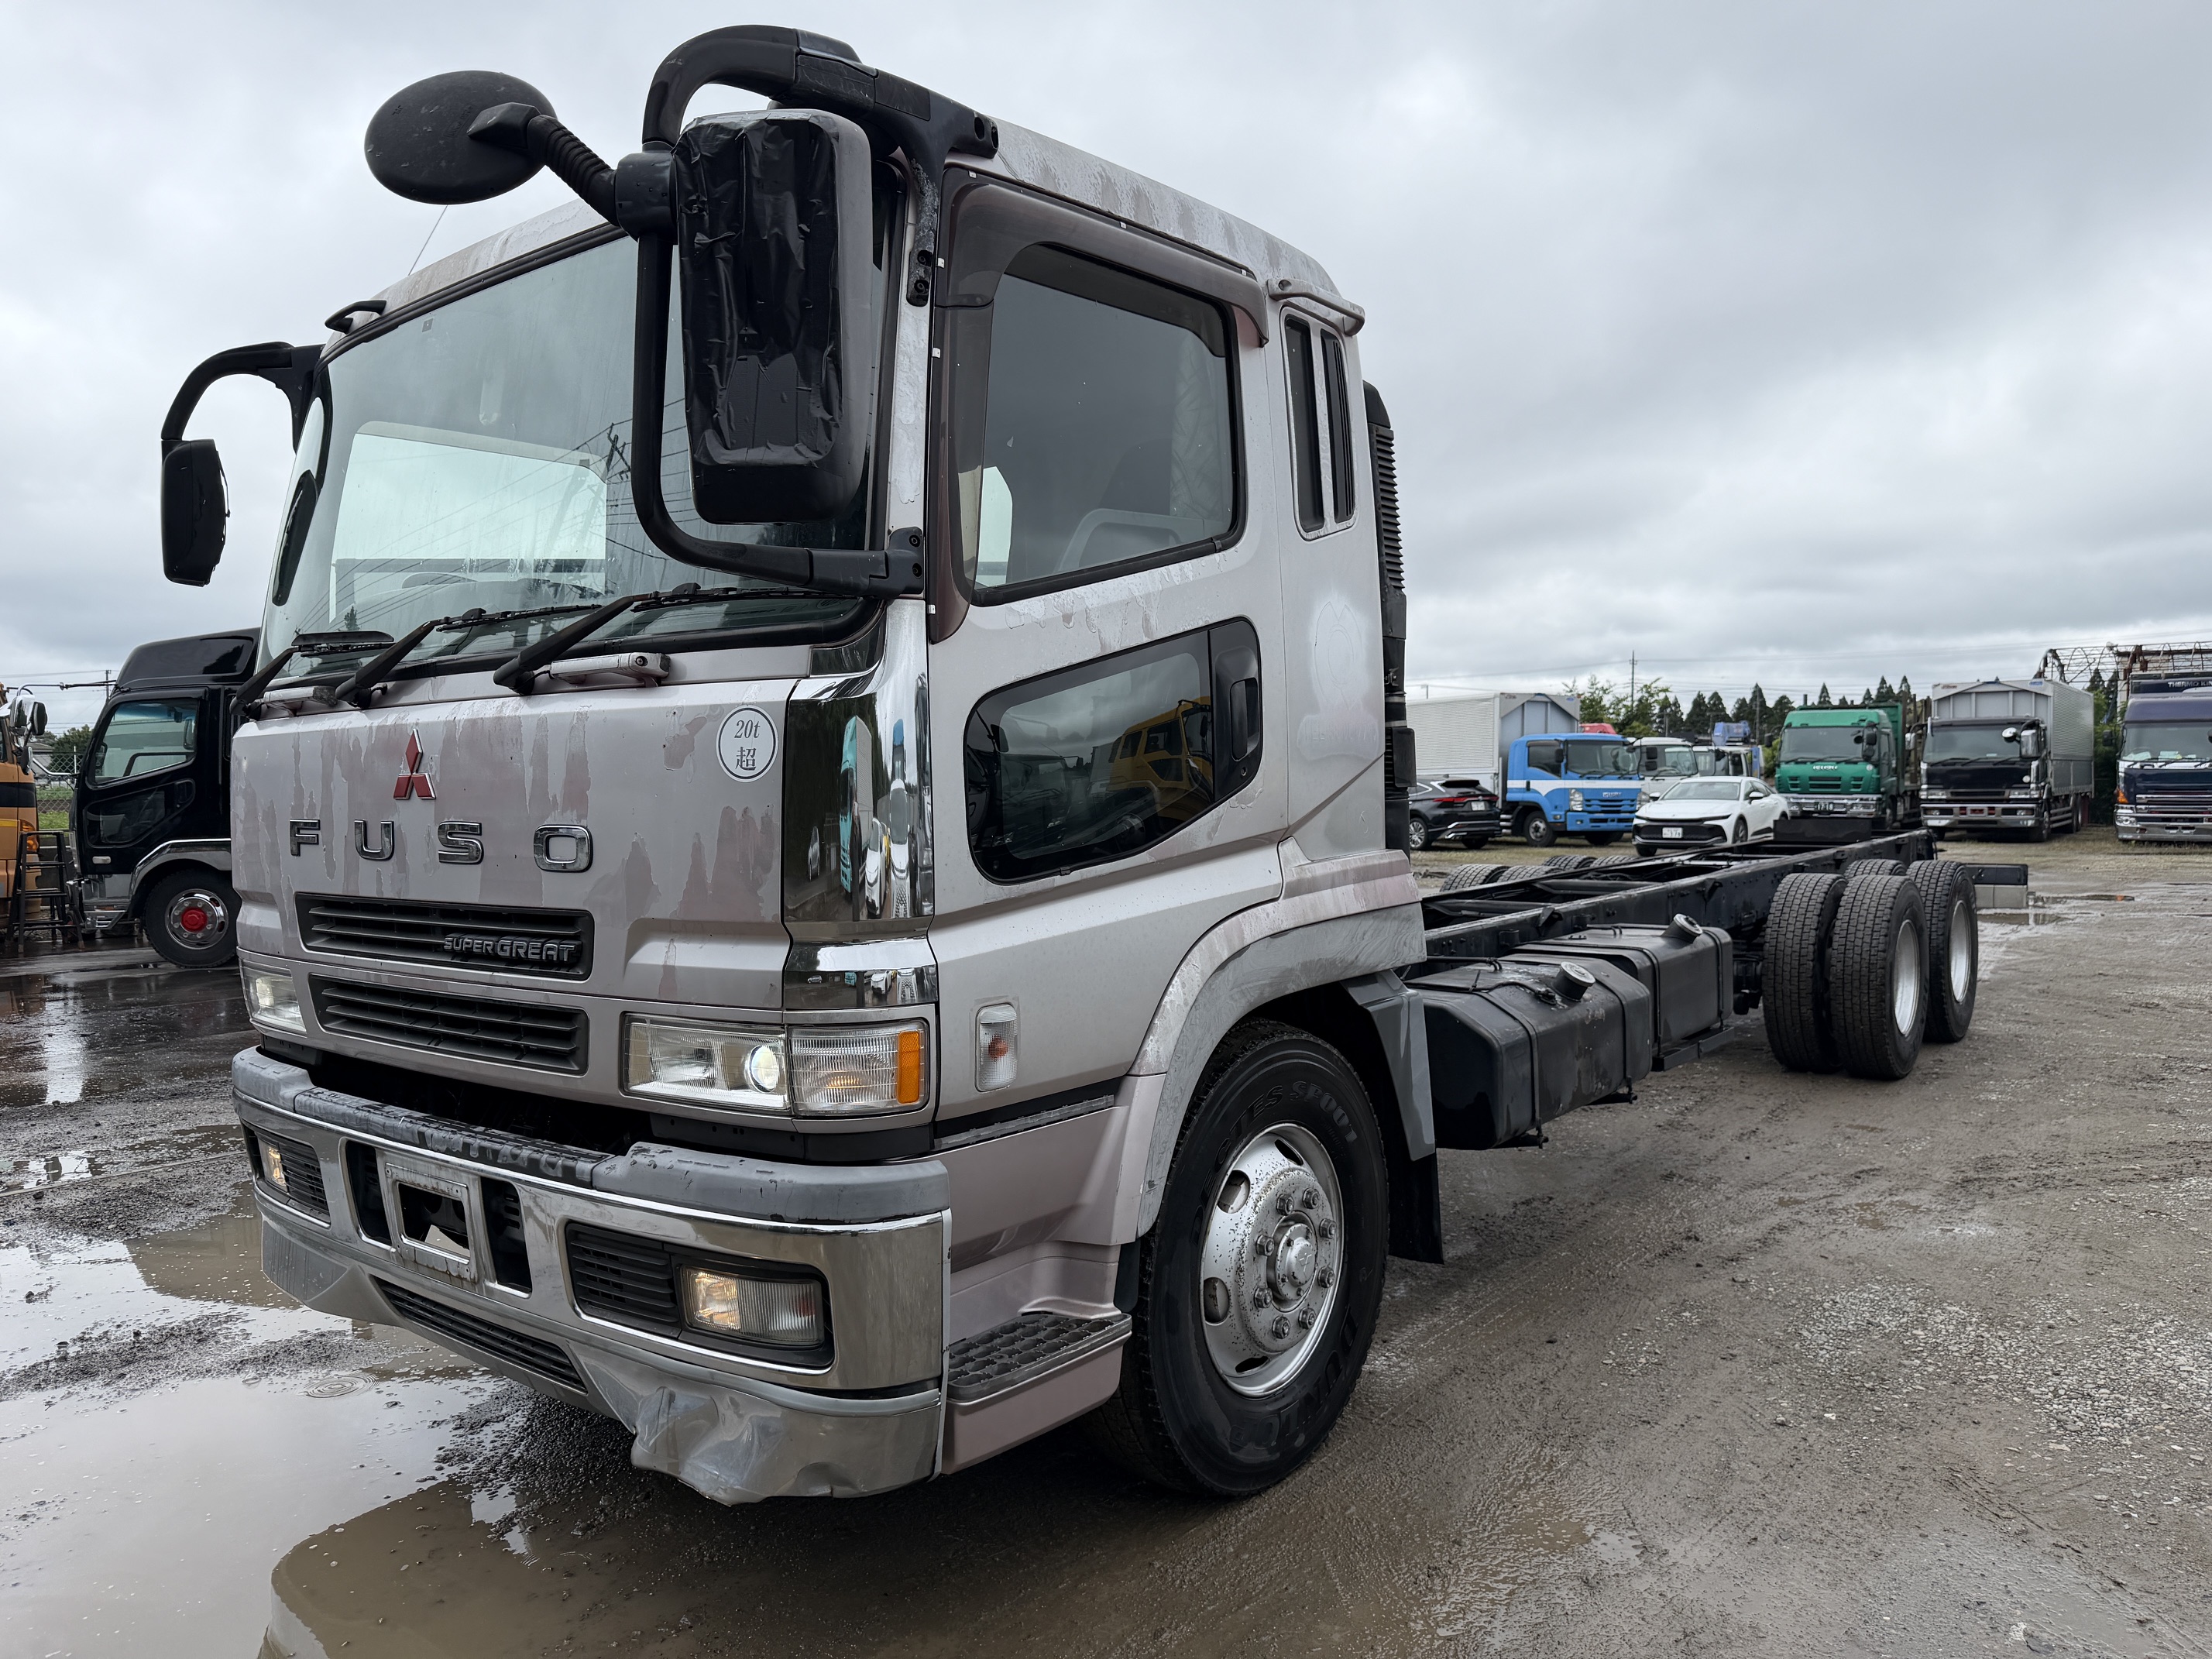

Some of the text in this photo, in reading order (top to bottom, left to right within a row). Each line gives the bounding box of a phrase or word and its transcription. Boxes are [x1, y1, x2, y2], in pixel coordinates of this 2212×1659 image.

[734, 720, 761, 739] 20t
[735, 746, 757, 771] 超
[289, 818, 594, 873] FUSO
